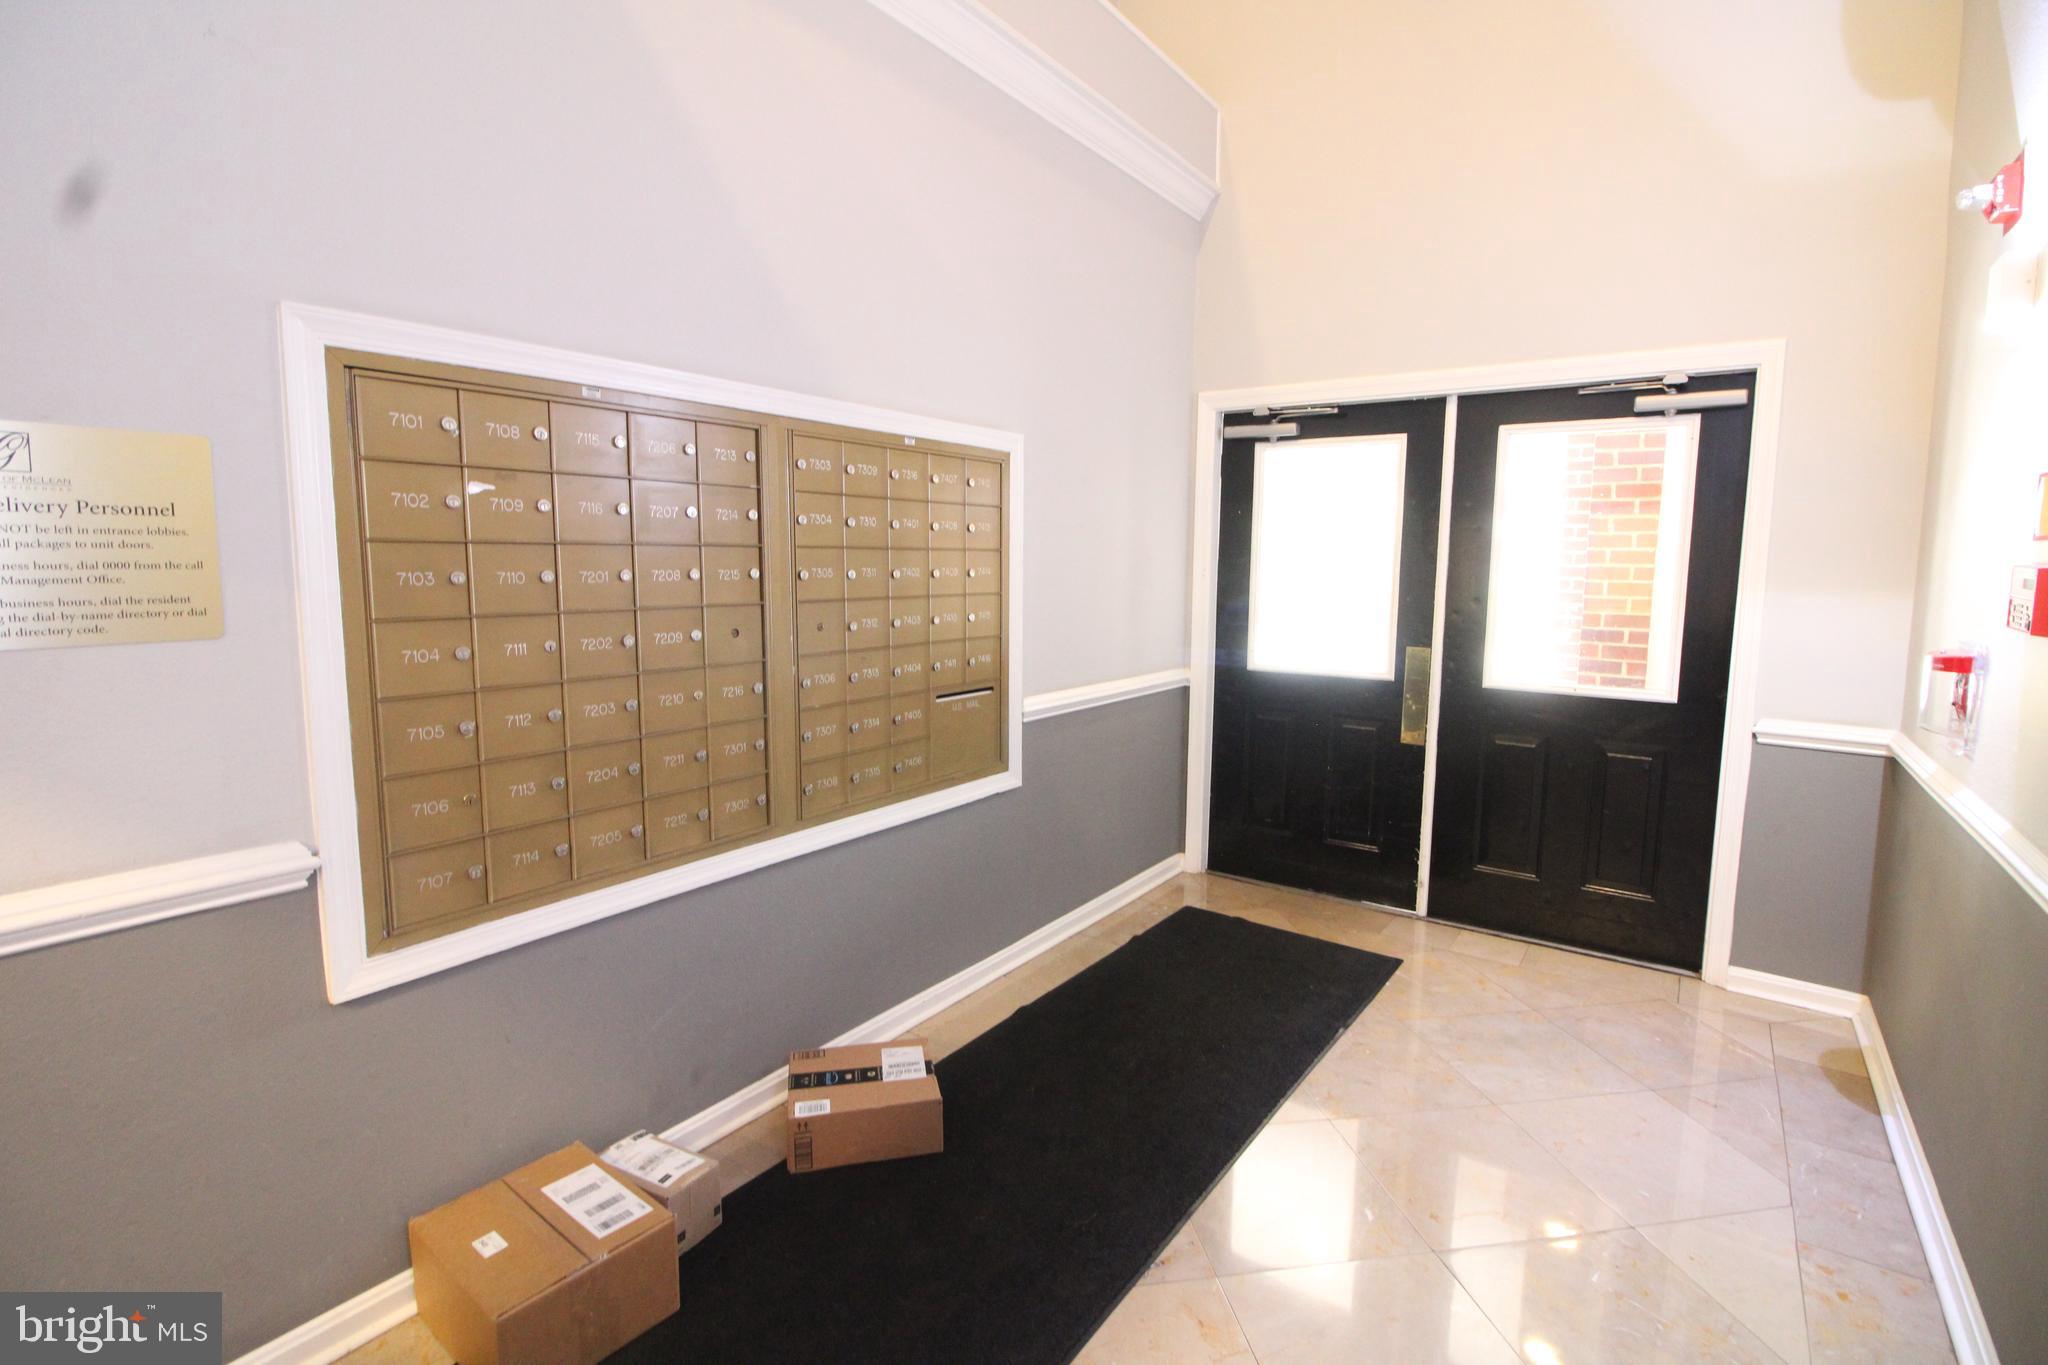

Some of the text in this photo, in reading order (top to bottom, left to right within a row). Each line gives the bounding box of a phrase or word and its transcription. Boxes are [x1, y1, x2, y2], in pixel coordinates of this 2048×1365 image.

[389, 412, 423, 429] 7101
[486, 422, 520, 439] 7108
[575, 431, 599, 446] 7115
[714, 448, 737, 462] 7213
[810, 459, 831, 471] 7303
[858, 464, 878, 476] 7309
[391, 492, 430, 508] 7102
[489, 497, 524, 512] 7109
[76, 500, 175, 517] Personnel
[578, 502, 603, 514] 7116
[650, 506, 679, 518] 7207
[715, 509, 738, 521] 7214
[810, 513, 832, 525] 7304
[859, 516, 877, 526] 7310
[35, 524, 50, 534] be
[54, 524, 72, 534] left
[77, 525, 89, 534] in
[93, 526, 143, 536] entrance
[147, 526, 189, 536] lobbies.
[902, 519, 919, 528] 7401
[15, 539, 71, 551] packages
[75, 540, 87, 548] to
[90, 540, 114, 549] unit
[118, 540, 154, 549] doors.
[2, 560, 204, 571] ness hours, dial 0000 from the call
[861, 567, 877, 577] 7311
[902, 567, 920, 577] 7402
[396, 572, 435, 586] 7103
[497, 571, 525, 585] 7110
[579, 571, 609, 583] 7201
[651, 569, 680, 582] 7208
[718, 569, 741, 581] 7215
[811, 567, 833, 578] 7305
[0, 575, 126, 587] Management Office.
[0, 595, 191, 608] business hours, dial the resident
[8, 613, 28, 622] the
[117, 610, 168, 620] directory
[187, 608, 207, 617] dial
[903, 615, 921, 625] 7403
[861, 618, 879, 628] 7312
[15, 627, 72, 638] directory
[76, 624, 109, 634] code.
[580, 638, 613, 651] 7202
[654, 632, 683, 645] 7209
[504, 643, 527, 656] 7111
[402, 649, 440, 664] 7104
[903, 663, 921, 674] 7404
[814, 672, 836, 685] 7306
[722, 685, 743, 698] 7216
[659, 694, 684, 707] 7210
[584, 703, 615, 717] 7203
[505, 713, 531, 728] 7112
[863, 717, 880, 729] 7314
[407, 725, 444, 742] 7105
[815, 725, 837, 737] 7307
[724, 742, 747, 756] 7301
[663, 754, 685, 768] 7211
[586, 766, 619, 783] 7204
[508, 782, 536, 798] 7113
[412, 800, 448, 817] 7106
[725, 799, 749, 814] 7302
[664, 814, 688, 829] 7212
[590, 831, 622, 848] 7205
[512, 850, 539, 866] 7114
[417, 872, 453, 892] 7107
